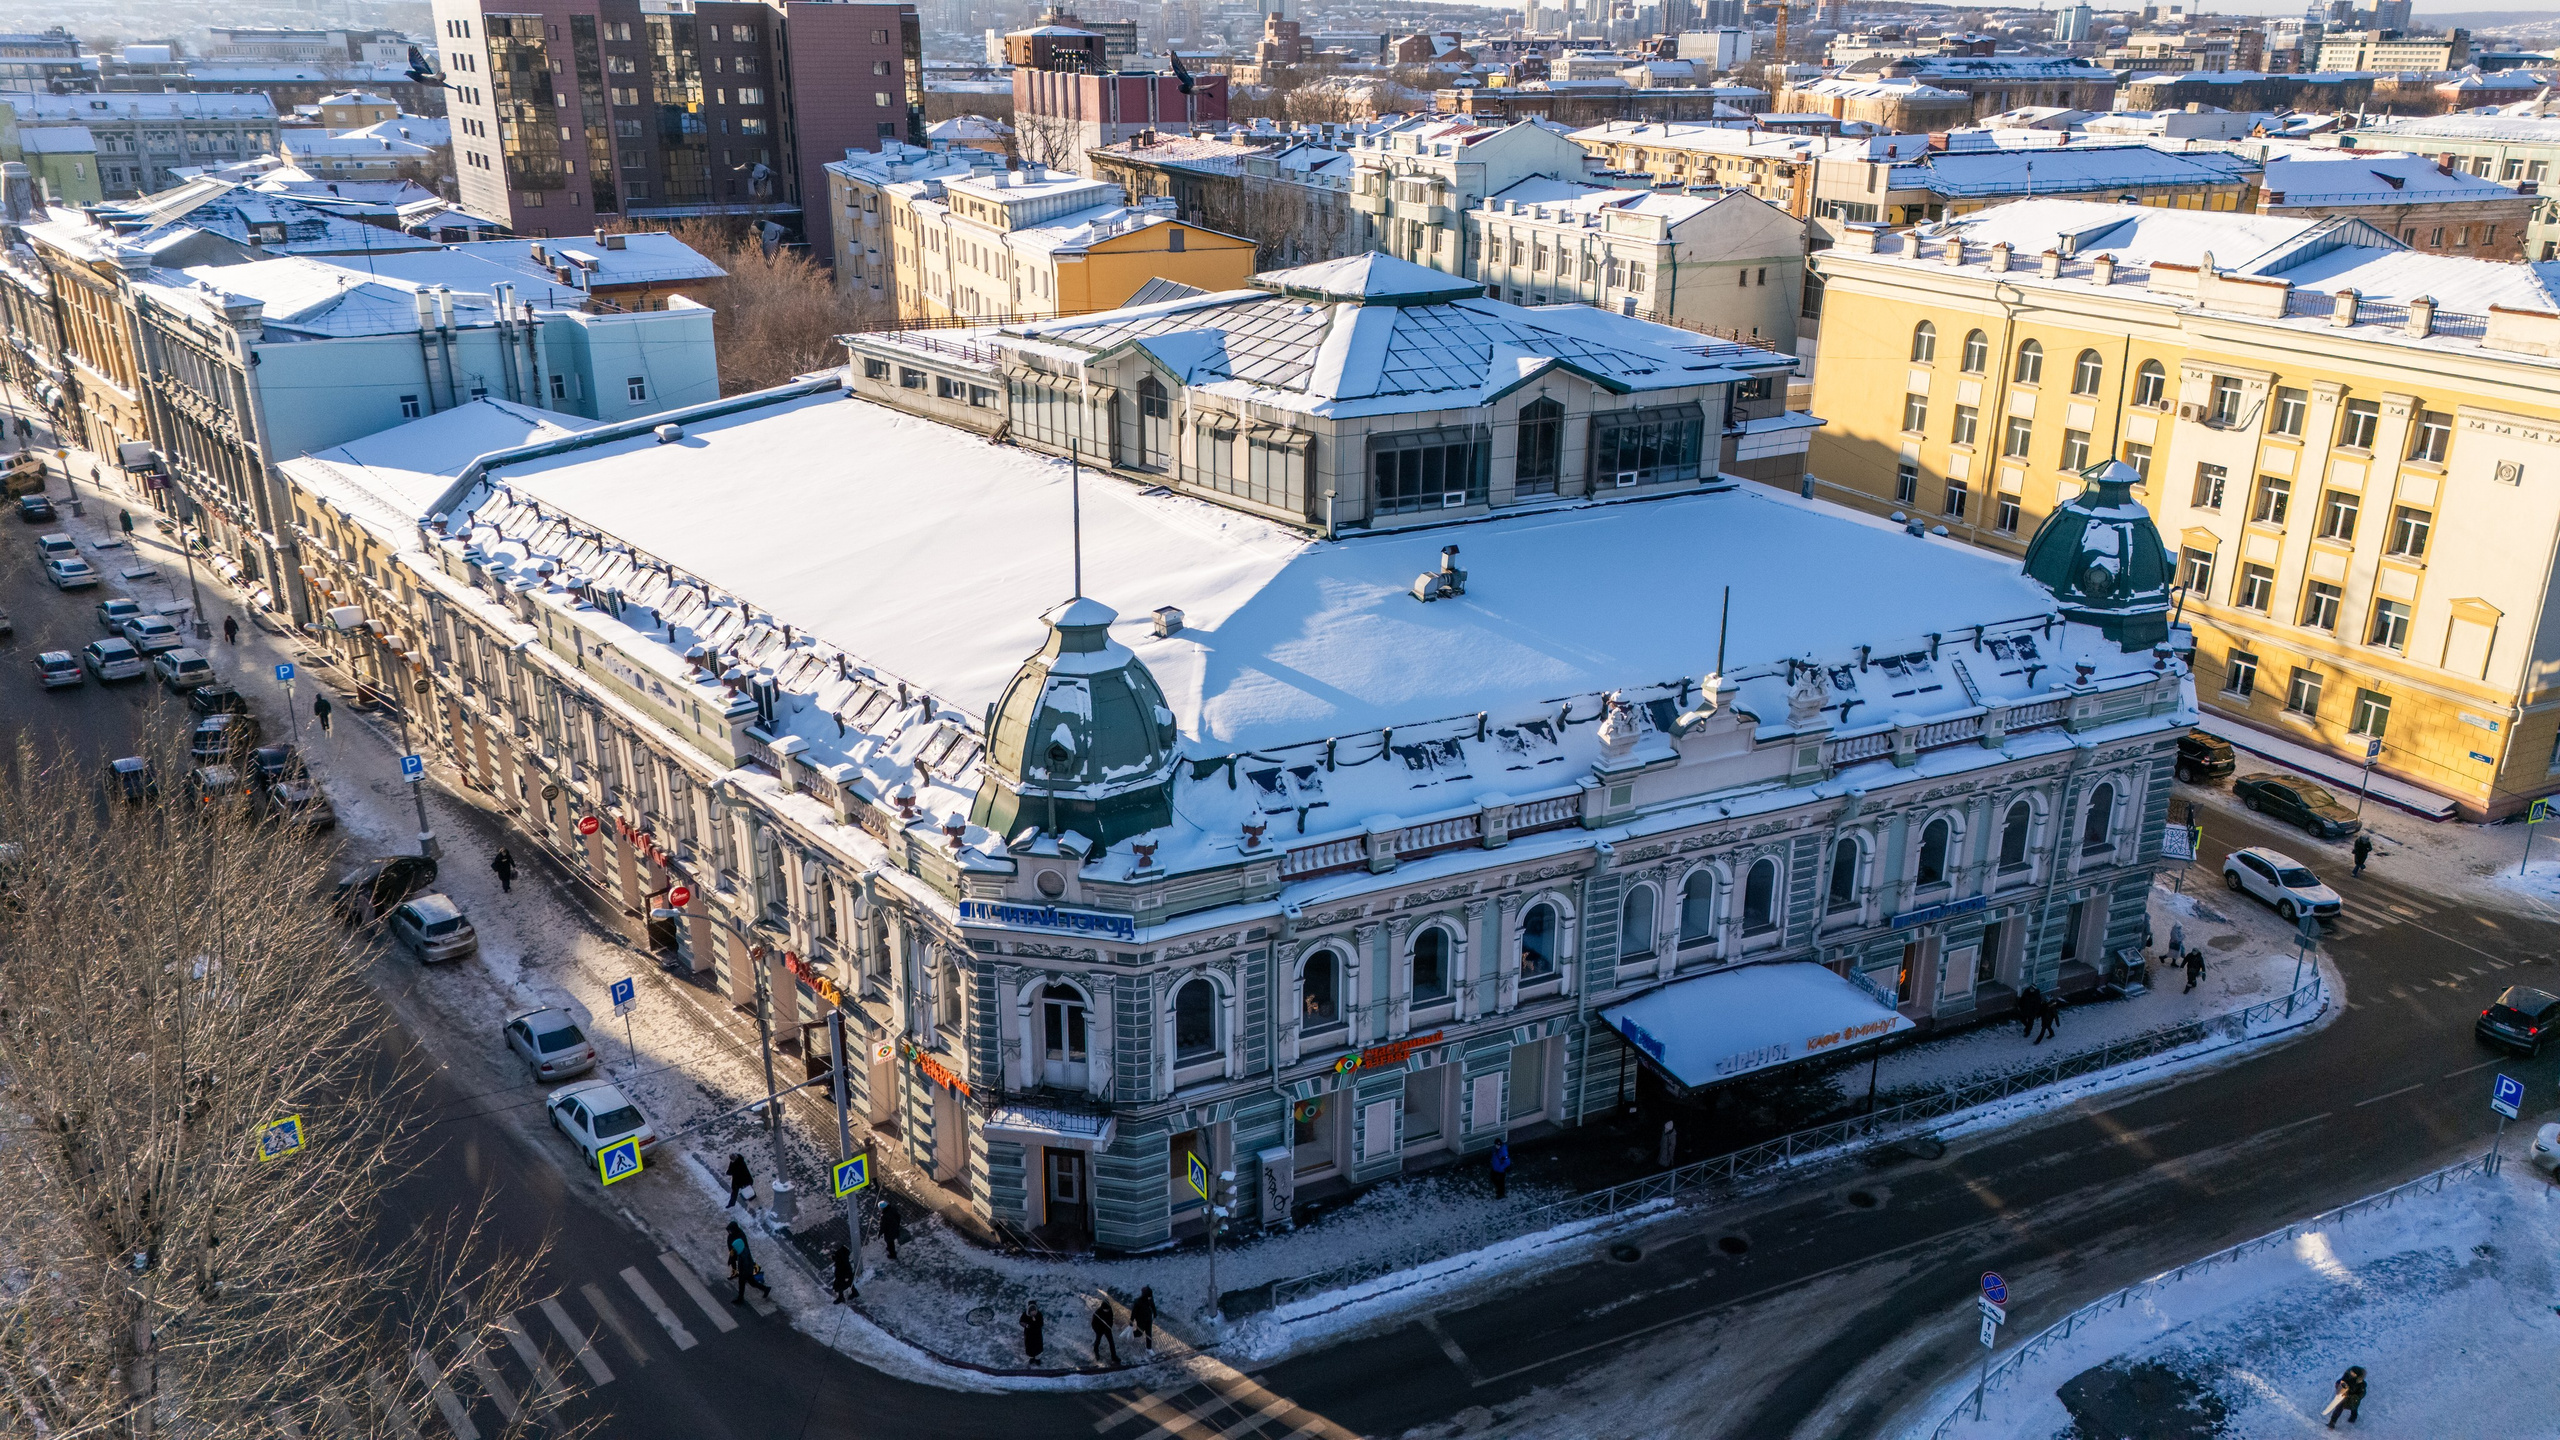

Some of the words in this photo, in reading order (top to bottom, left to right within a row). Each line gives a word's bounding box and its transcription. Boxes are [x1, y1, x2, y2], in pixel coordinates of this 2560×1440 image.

[279, 665, 290, 679] P
[2368, 741, 2378, 756] P
[406, 757, 418, 772] P
[991, 905, 1135, 939] ЧИТАЙ-ГОРОД
[616, 982, 628, 1002] P
[1854, 1016, 1900, 1039] МИНУТ
[1364, 1029, 1444, 1060] СЧАСТЛИВЫЙ
[2500, 1079, 2516, 1097] P
